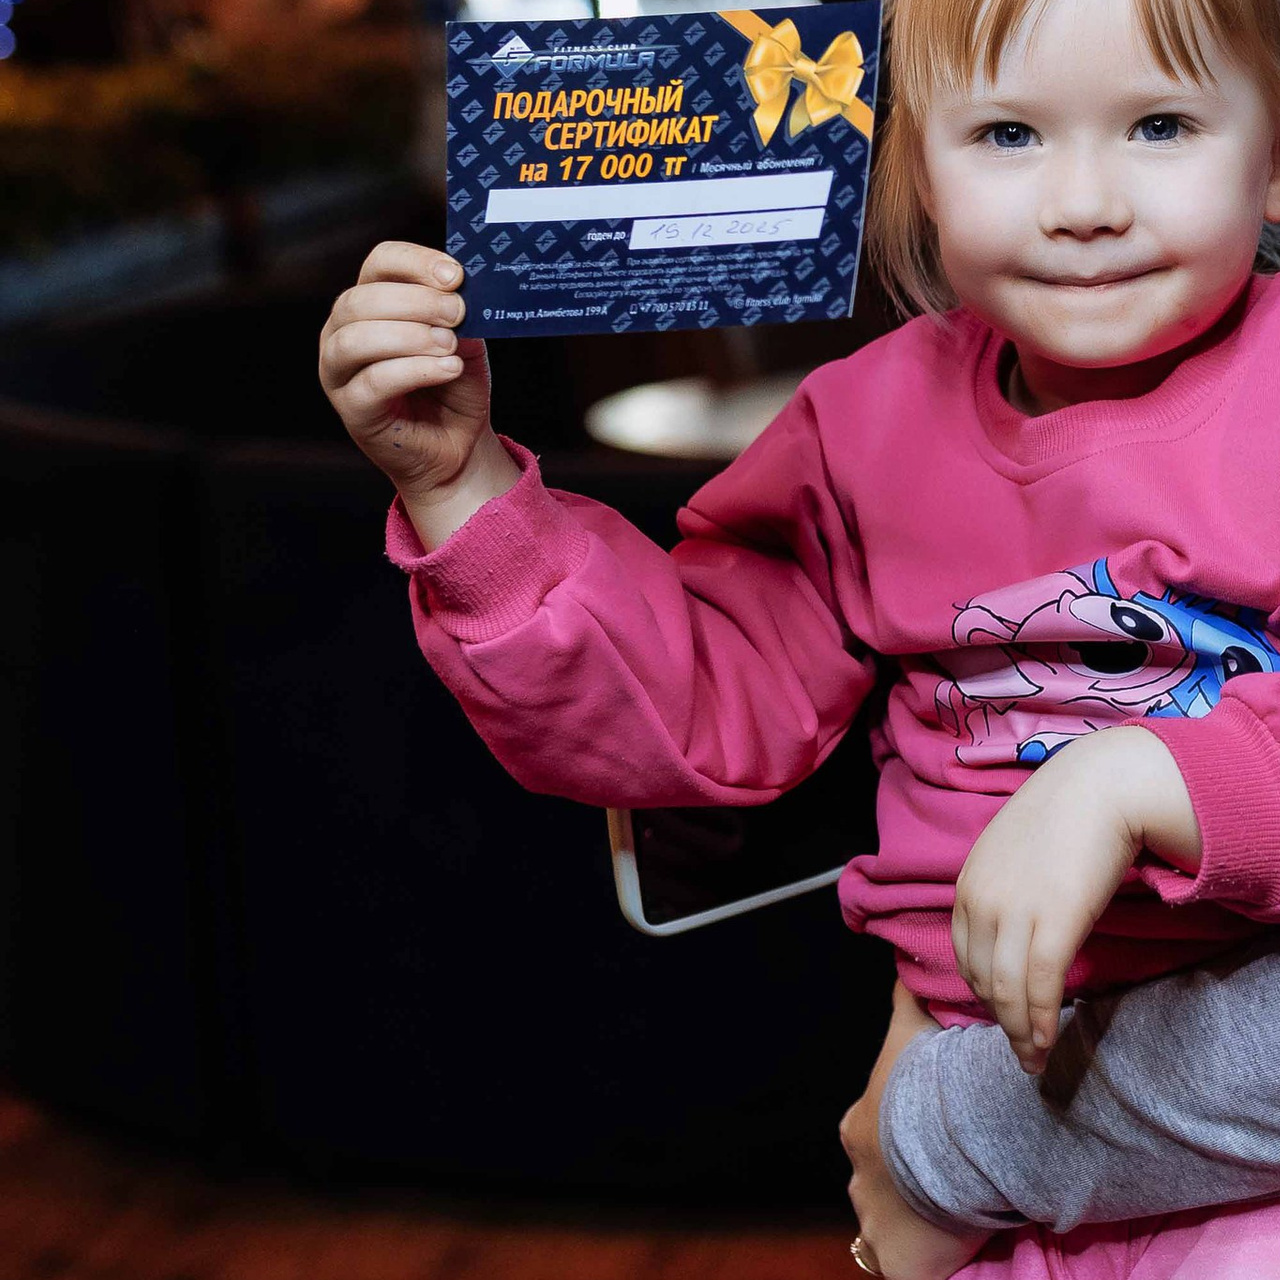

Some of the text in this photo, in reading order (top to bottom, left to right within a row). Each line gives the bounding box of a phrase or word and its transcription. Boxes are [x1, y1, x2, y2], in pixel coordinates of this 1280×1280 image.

[553, 43, 637, 53] FITNESS CLUB
[534, 51, 655, 71] FORMULA
[493, 79, 685, 123] ПОДАРОЧНЫЙ
[544, 114, 719, 151] СЕРТИФИКАТ
[519, 162, 549, 182] на
[559, 155, 594, 180] 17
[600, 152, 653, 179] 000
[664, 156, 688, 176] тг
[587, 231, 626, 241] годен до
